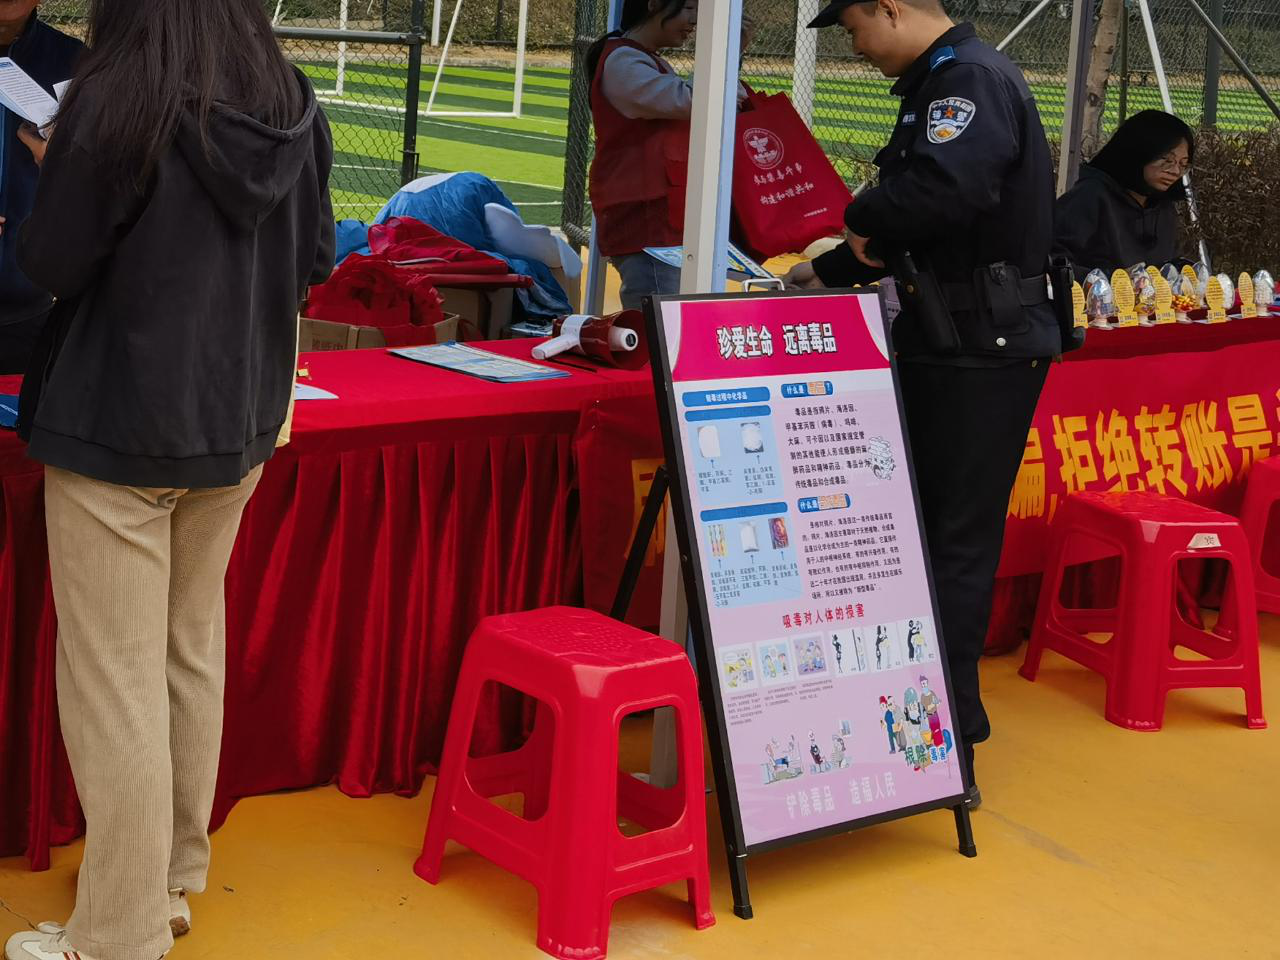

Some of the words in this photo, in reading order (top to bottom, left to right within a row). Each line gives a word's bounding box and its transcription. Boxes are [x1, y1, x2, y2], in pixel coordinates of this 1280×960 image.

[716, 325, 774, 360] 珍爱生命
[782, 322, 838, 356] 远离毒品
[782, 603, 865, 628] 吸毒对人体的损害
[849, 771, 896, 806] 造福人民
